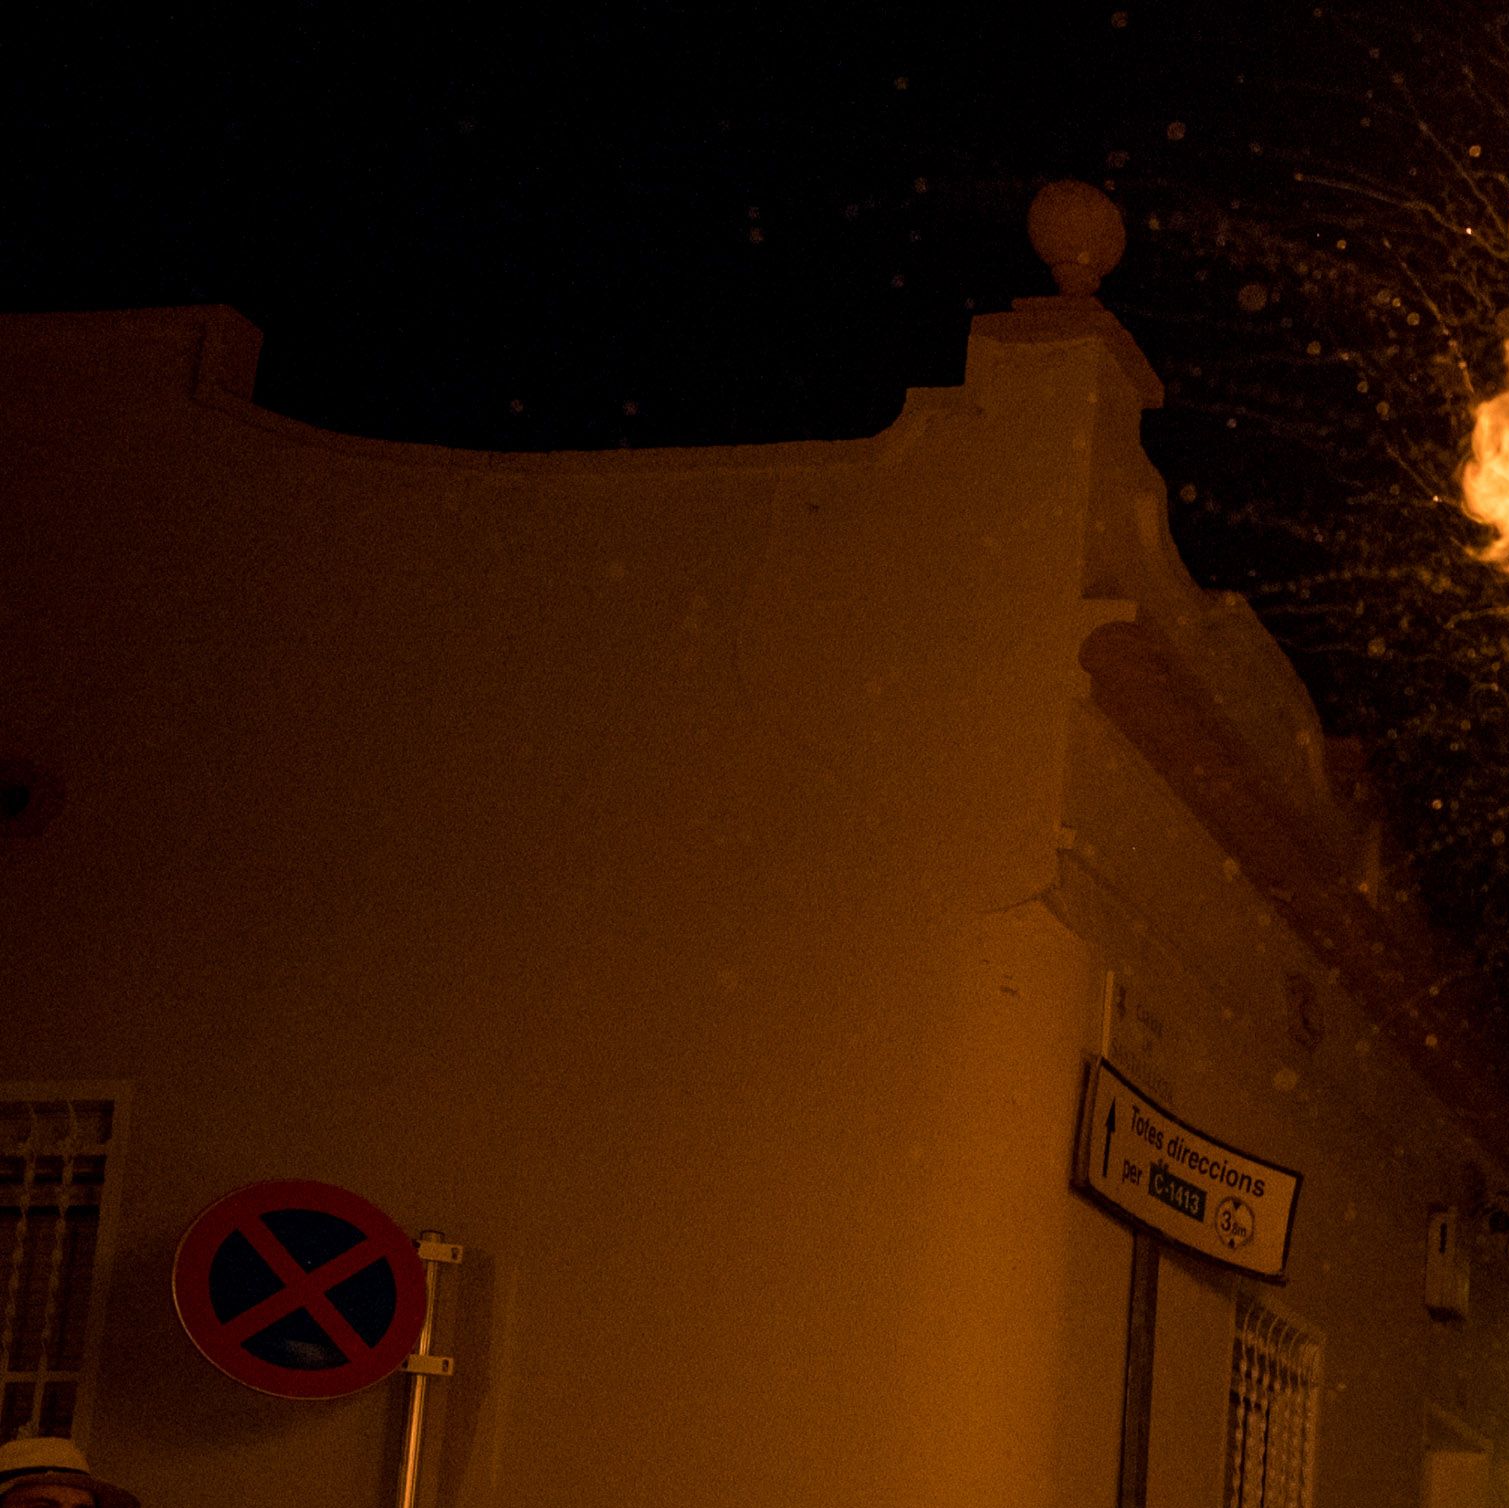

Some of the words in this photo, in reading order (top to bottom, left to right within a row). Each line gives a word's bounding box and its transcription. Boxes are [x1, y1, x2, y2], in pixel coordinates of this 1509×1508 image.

[1122, 1159, 1143, 1186] per
[1153, 1172, 1201, 1216] C-1413
[1131, 1103, 1164, 1151] Totes
[1167, 1136, 1266, 1197] direccions
